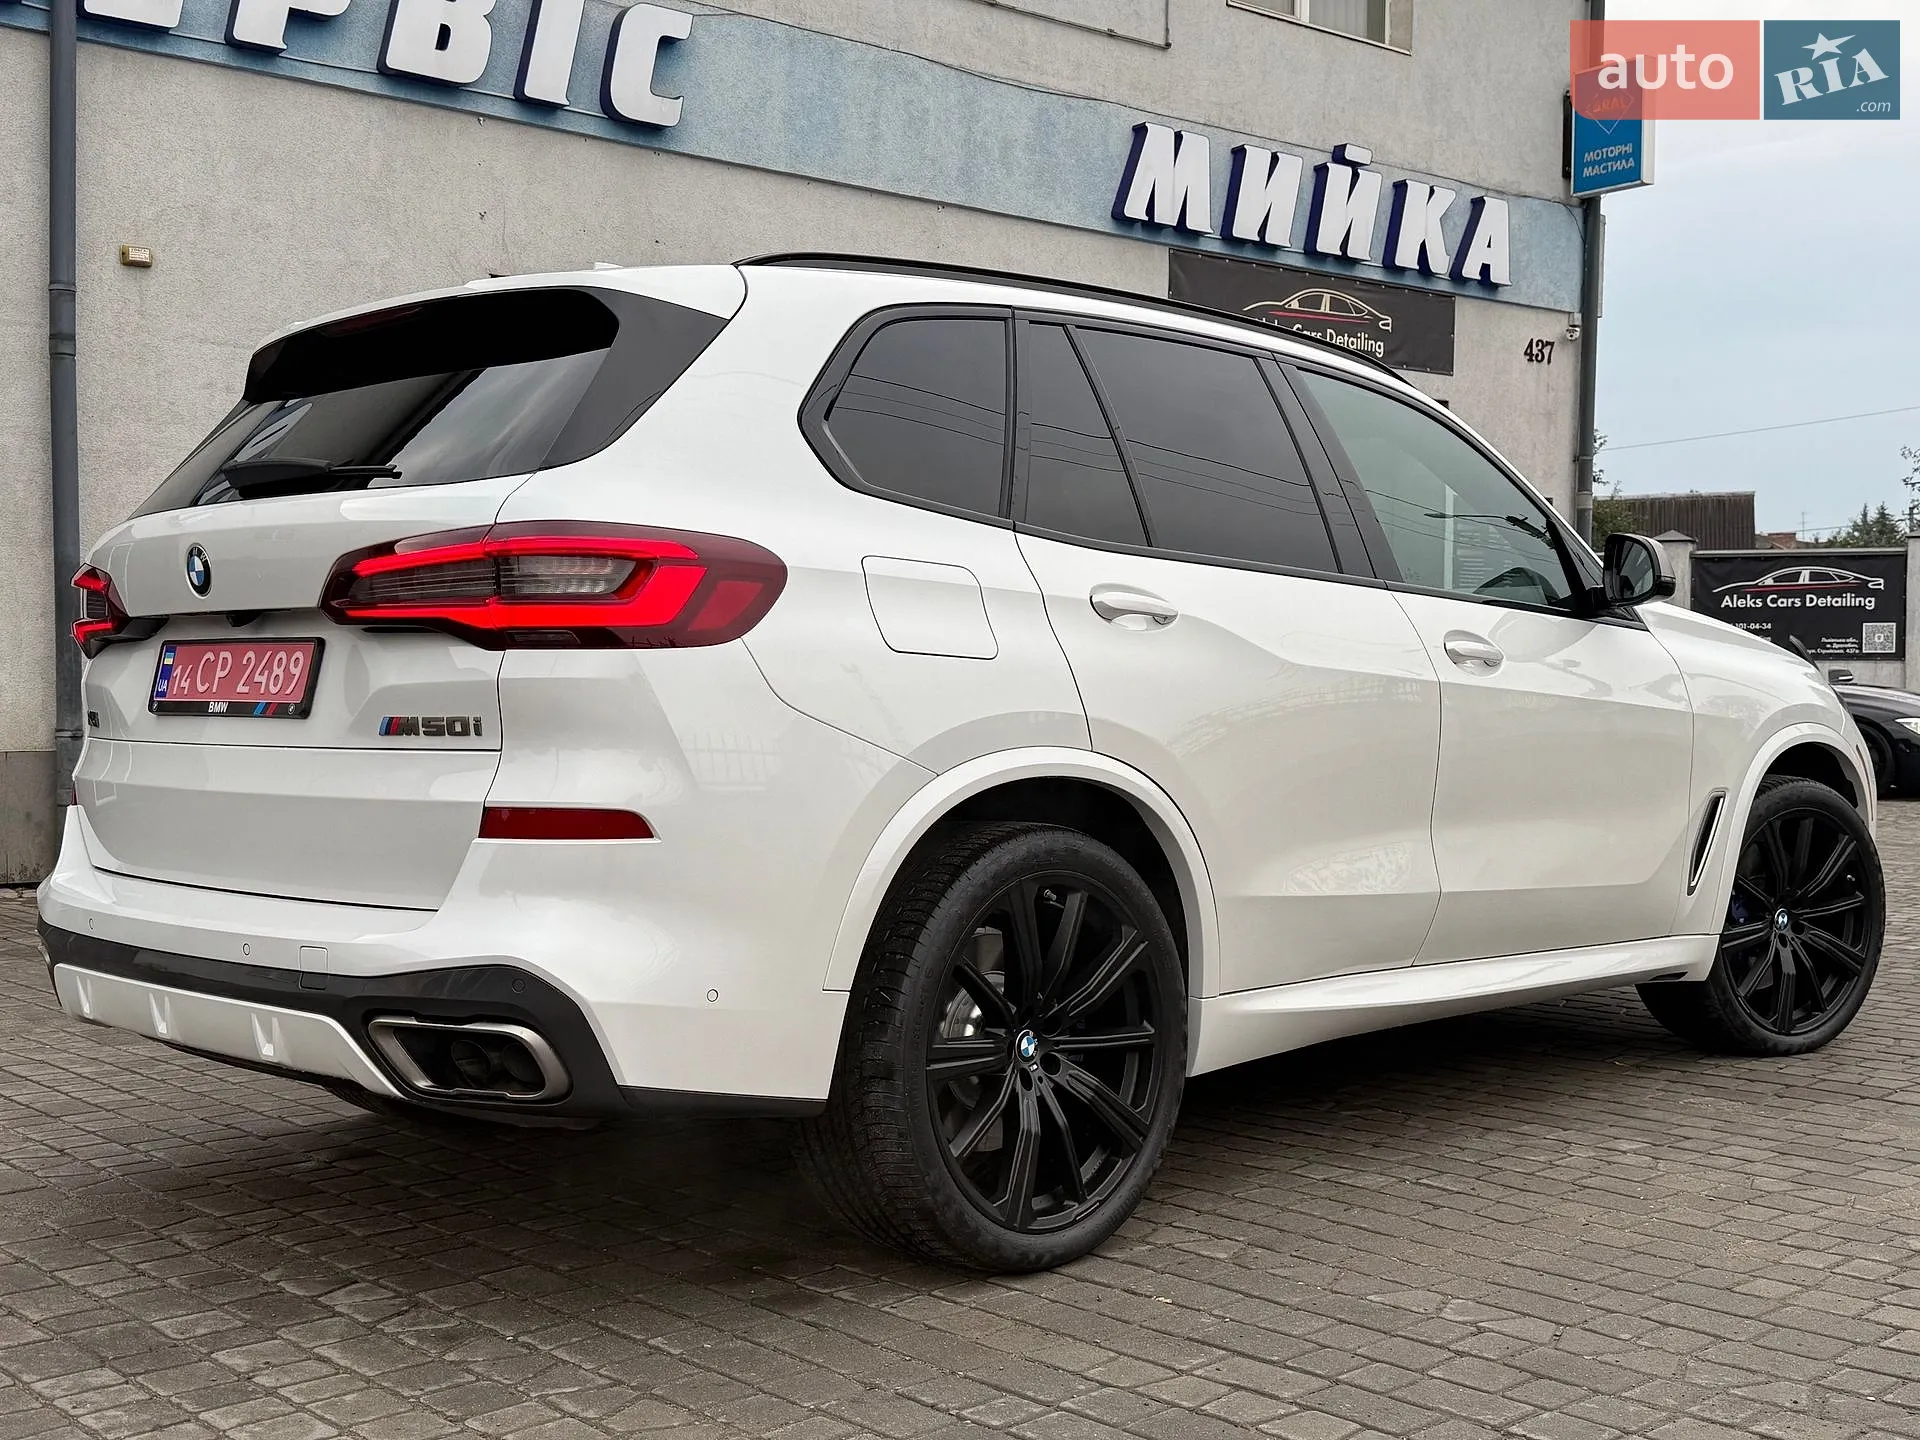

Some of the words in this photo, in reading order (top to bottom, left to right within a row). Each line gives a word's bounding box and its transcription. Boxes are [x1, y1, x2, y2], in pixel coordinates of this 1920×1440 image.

[1583, 143, 1633, 163] МОТОРНІ
[1582, 158, 1636, 178] МАСТИЛА
[1112, 122, 1512, 286] МИЙКА
[1326, 328, 1384, 357] Detailing
[1523, 338, 1555, 366] 437
[1720, 594, 1763, 609] Aleks
[1766, 594, 1801, 608] Cars
[1805, 592, 1875, 610] Detailing
[158, 679, 168, 692] UA
[172, 664, 193, 695] 14
[196, 651, 233, 693] CP
[236, 650, 305, 695] 2489
[208, 701, 229, 713] BMW
[392, 716, 483, 736] M50i
